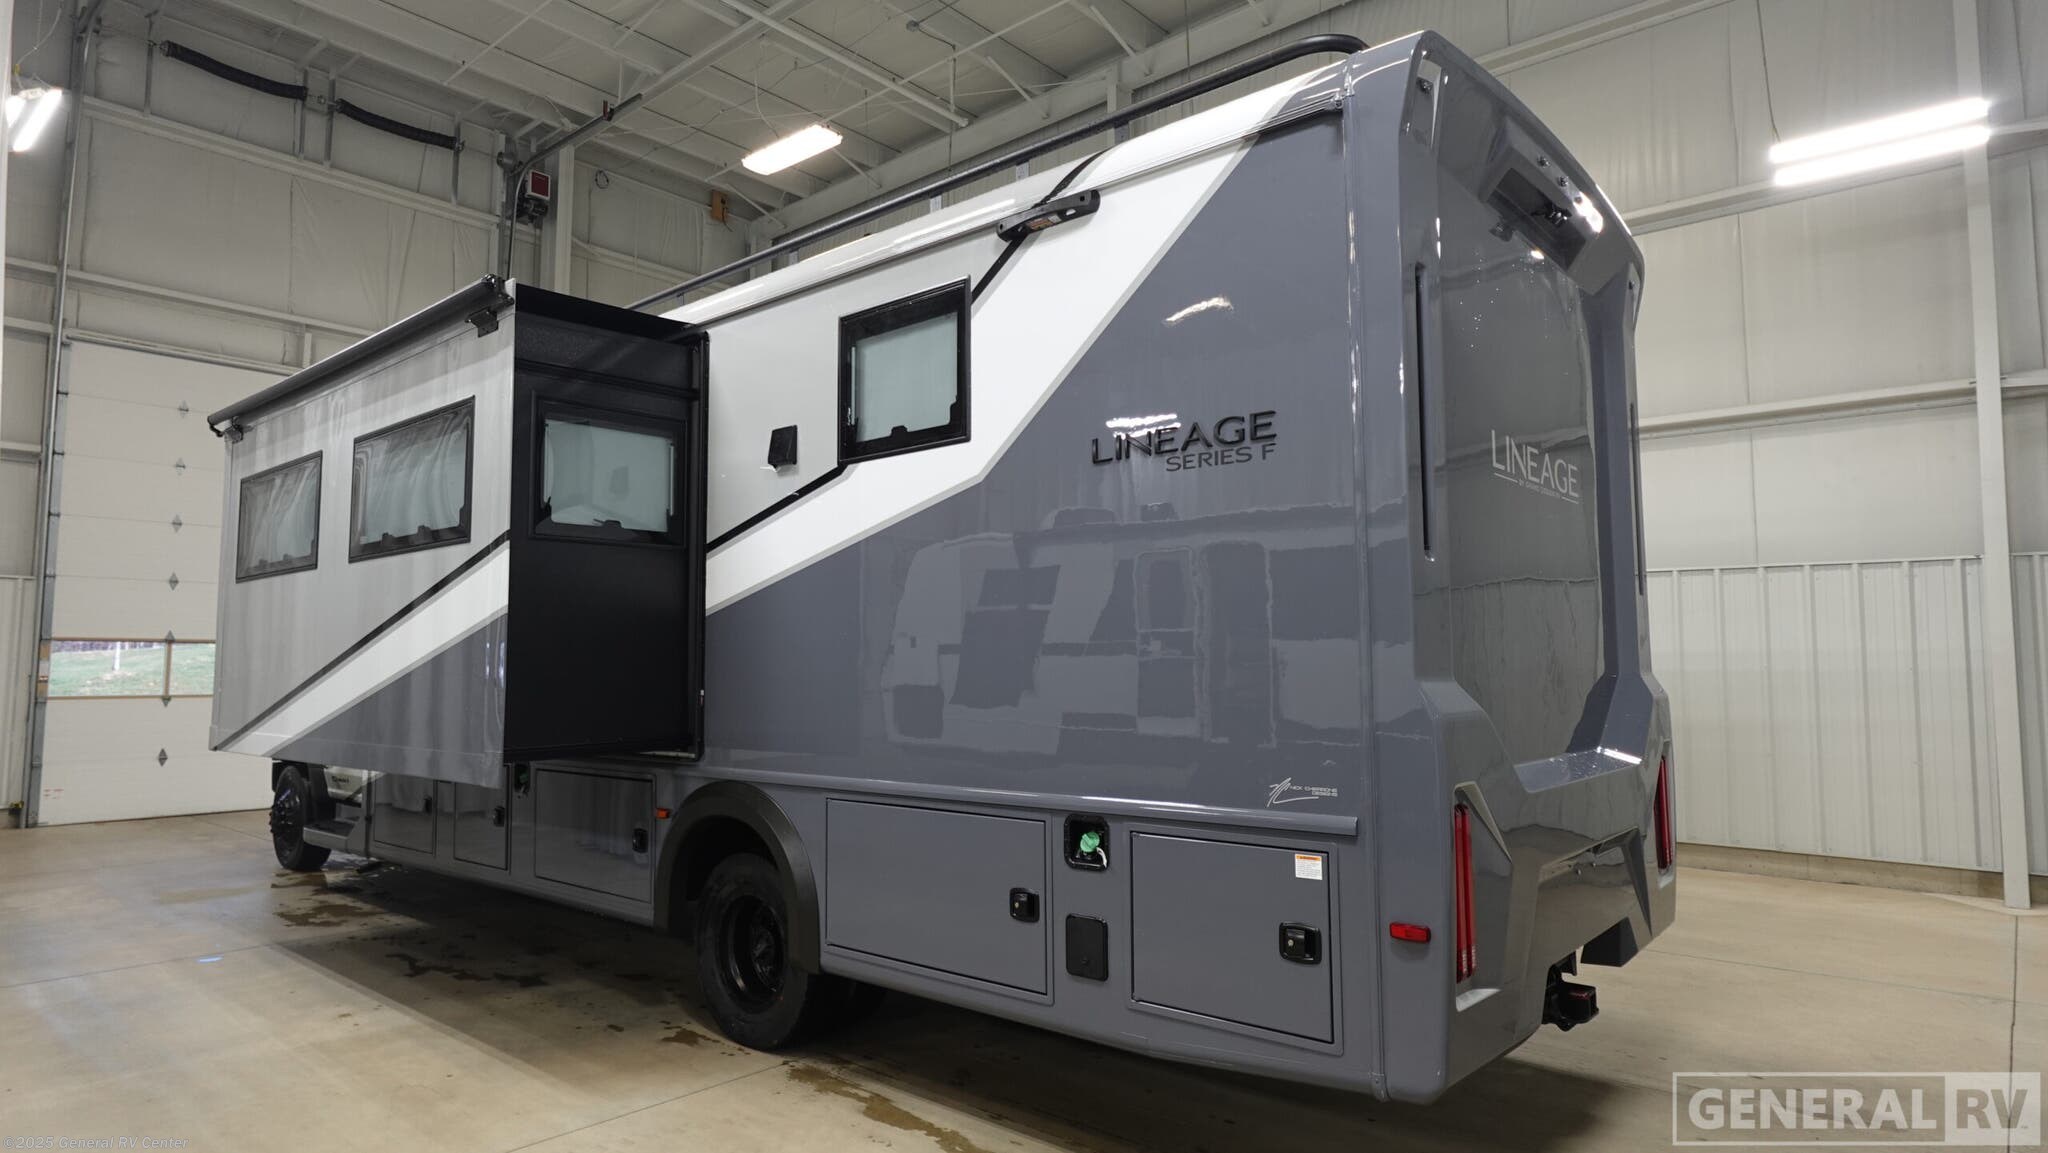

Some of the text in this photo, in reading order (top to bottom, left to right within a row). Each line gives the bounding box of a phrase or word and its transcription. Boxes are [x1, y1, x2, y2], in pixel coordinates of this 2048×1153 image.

[1092, 410, 1277, 465] LINEAGE
[1166, 443, 1277, 472] SERIES F
[1491, 429, 1579, 498] LINEAGE
